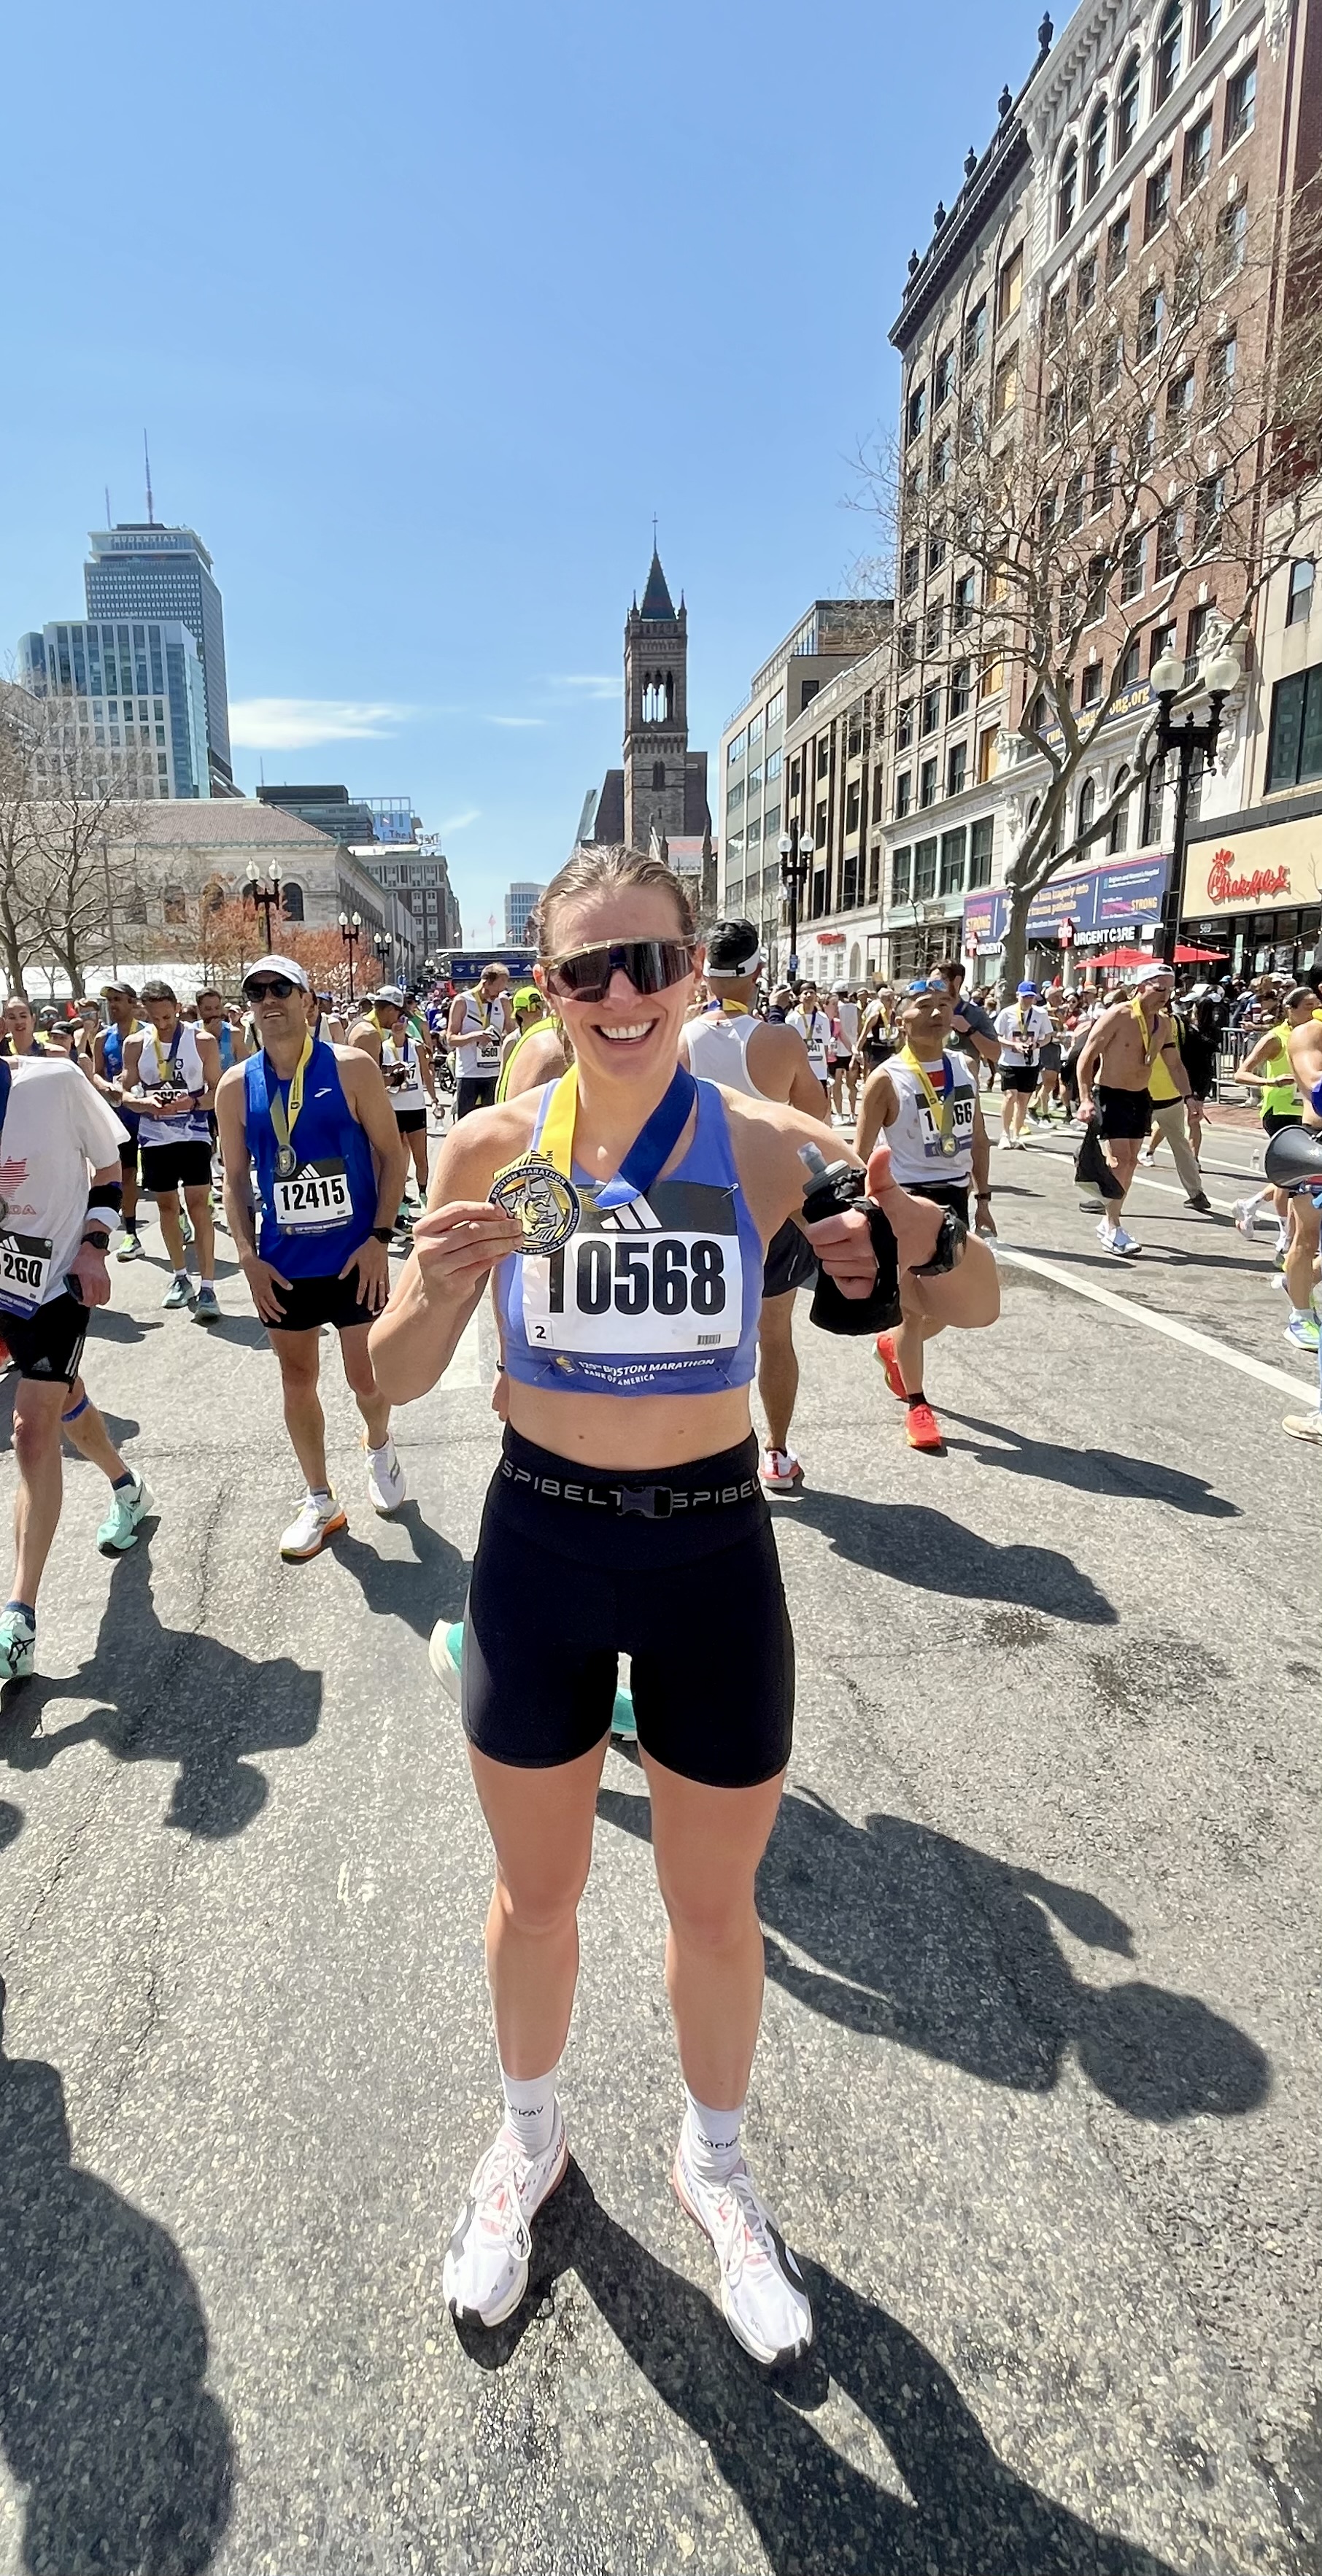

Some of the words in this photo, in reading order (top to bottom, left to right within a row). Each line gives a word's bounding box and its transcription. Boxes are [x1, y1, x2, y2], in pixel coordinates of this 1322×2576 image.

[108, 534, 176, 543] PRUDENTIAL
[1131, 896, 1158, 911] STRONG
[1073, 929, 1109, 947] URGENT
[924, 1102, 972, 1132] 166
[281, 1178, 345, 1211] 12415
[492, 1173, 519, 1199] BOSTON
[519, 1169, 566, 1185] MARATHON
[558, 1207, 579, 1245] ASSOCIATION
[0, 1253, 42, 1288] 260
[542, 1239, 726, 1315] 10568
[534, 1325, 546, 1339] 2
[584, 1369, 607, 1380] BANK
[607, 1374, 617, 1384] OF
[617, 1373, 655, 1386] AMERICA
[603, 1356, 647, 1377] BOSTON
[649, 1351, 716, 1372] MARATHON
[501, 1460, 622, 1506] SPIBELT
[673, 1477, 760, 1508] SPIBEL
